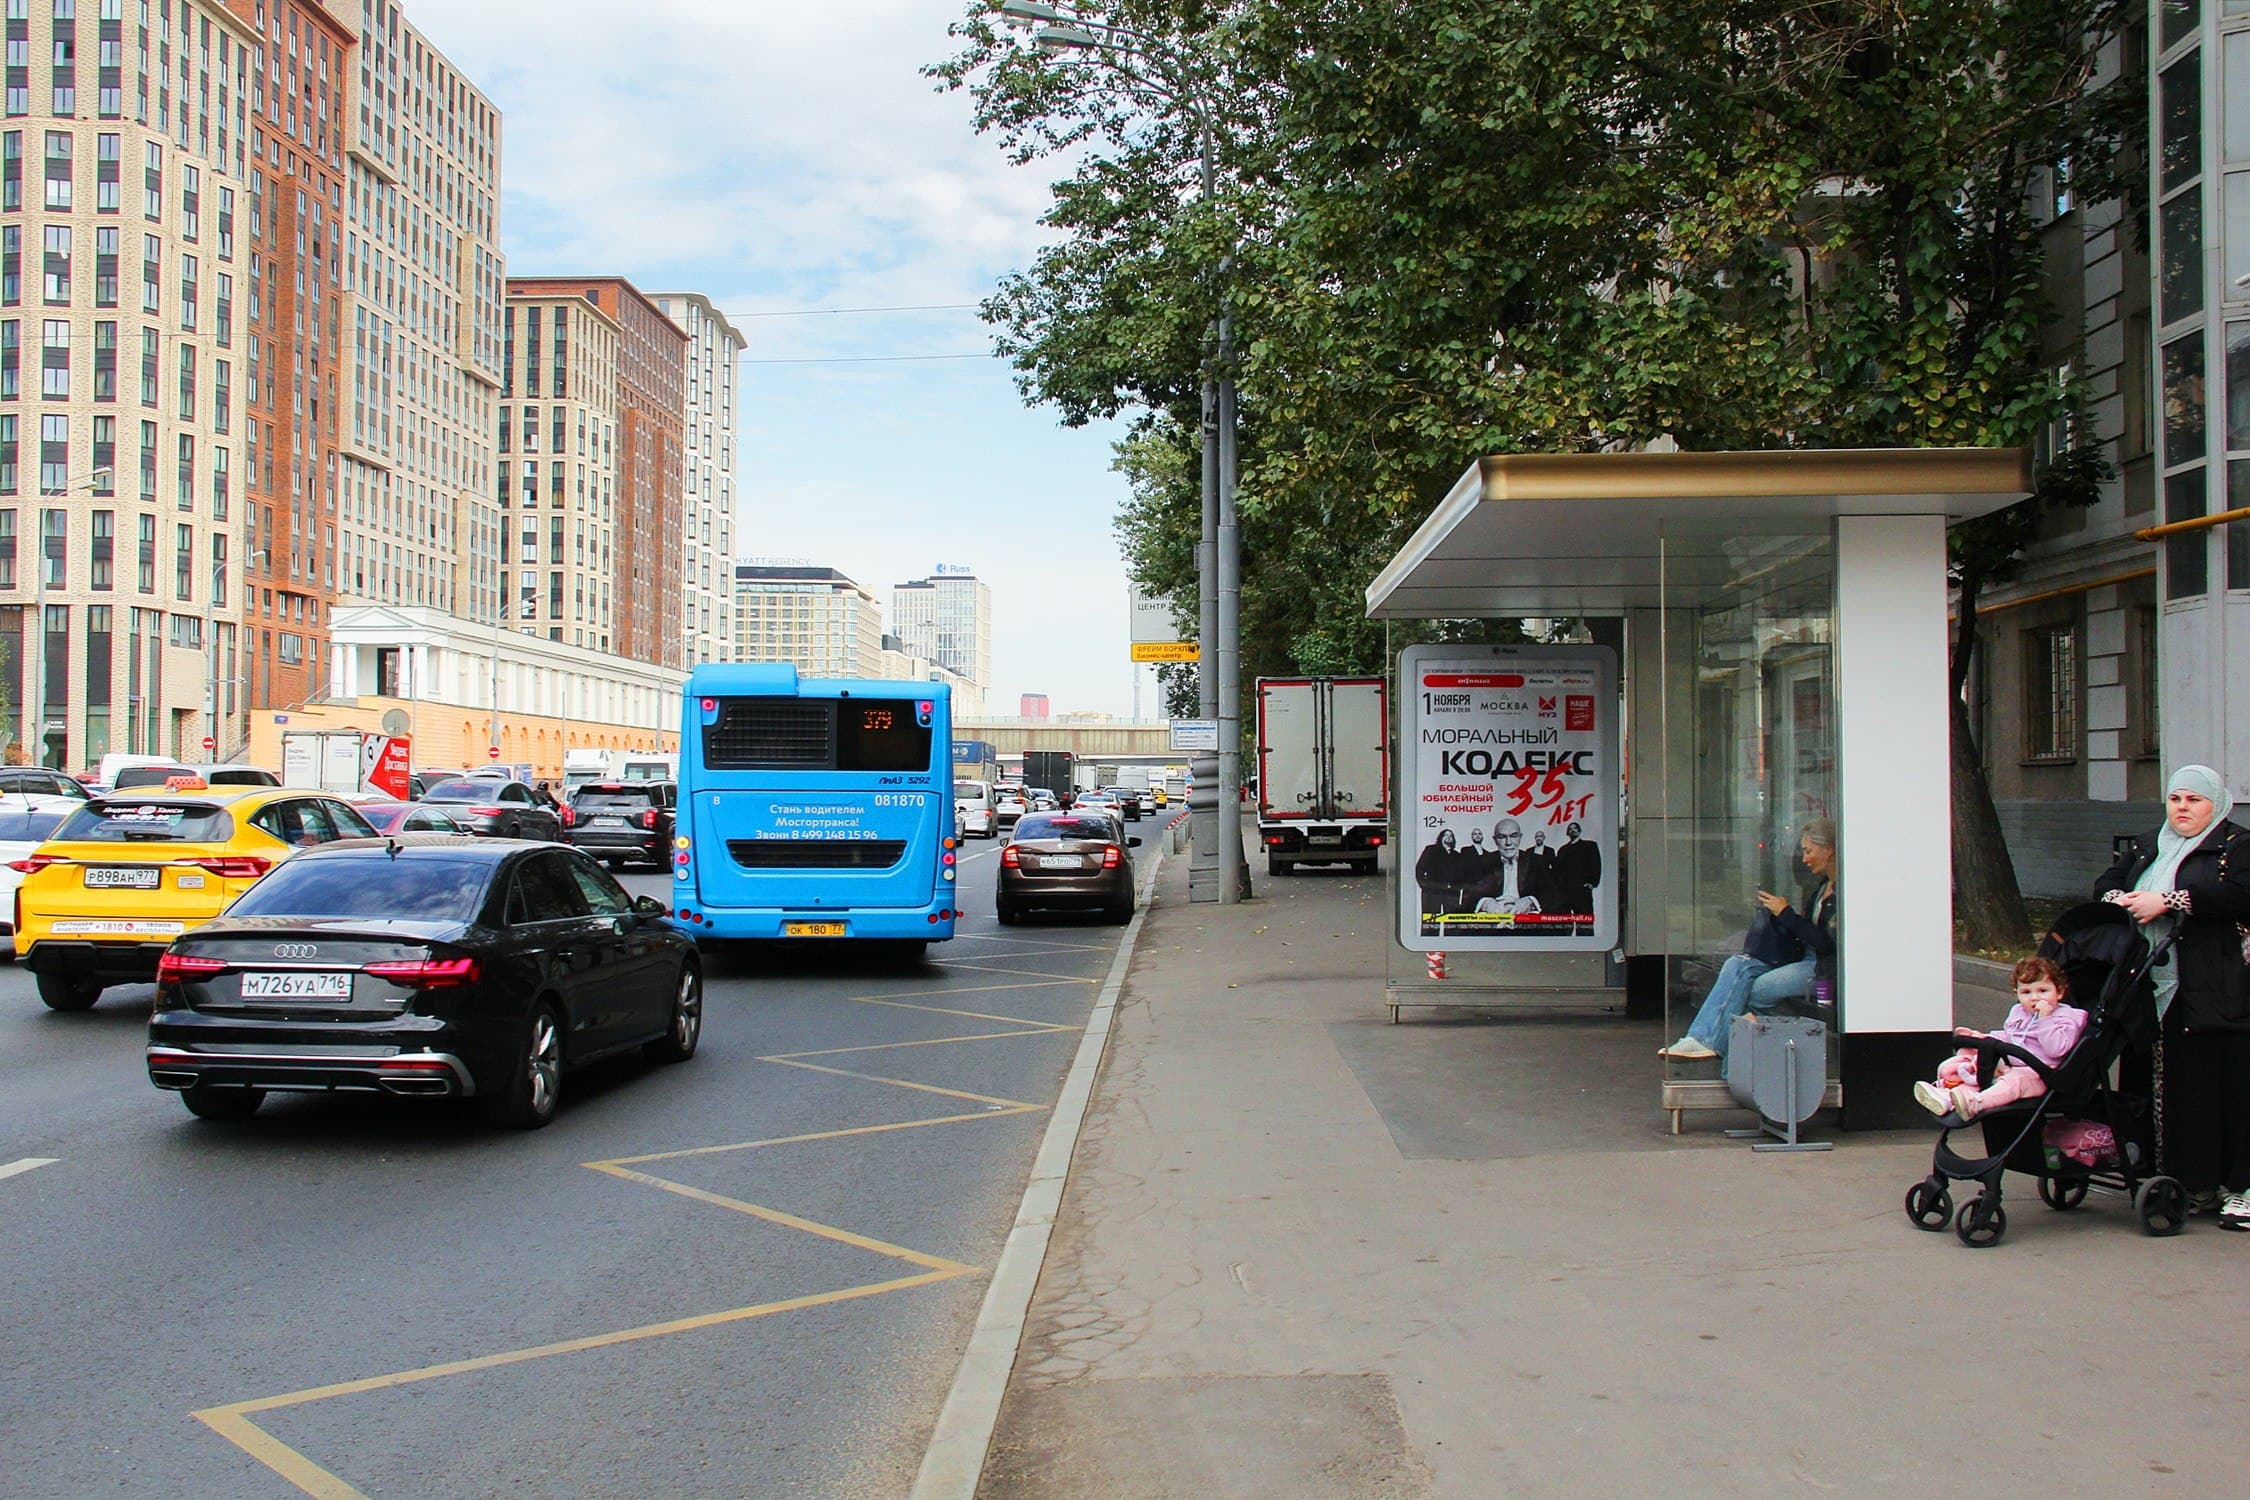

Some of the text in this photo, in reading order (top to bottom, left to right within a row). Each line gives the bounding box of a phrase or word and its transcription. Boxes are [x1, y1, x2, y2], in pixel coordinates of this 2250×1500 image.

[1137, 603, 1167, 612] ЦЕНТР
[1423, 692, 1431, 715] 1
[1433, 694, 1471, 706] НОЯБРЯ
[1480, 701, 1529, 711] МОСКВА
[1423, 726, 1558, 744] МОРАЛЬНЫЙ
[1441, 750, 1594, 780] КОДЕКС
[907, 776, 931, 785] 5292
[1439, 783, 1494, 792] БОЛЬШОЙ
[1506, 761, 1573, 817] 35
[874, 794, 925, 807] 081870
[1423, 793, 1494, 802] ЮБИЛЕЙНЫЙ
[769, 804, 865, 815] Стань водителем
[1443, 805, 1494, 814] КОНЦЕРТ
[1547, 793, 1595, 826] ЛЕТ
[775, 817, 860, 828] Мосгортранса!
[1423, 816, 1446, 828] 12+
[755, 830, 878, 840] Звони 8 499 148 15 96
[137, 870, 155, 879] 977
[1541, 913, 1593, 922] moscow-hall.ru
[247, 975, 346, 994] М726УА 716
